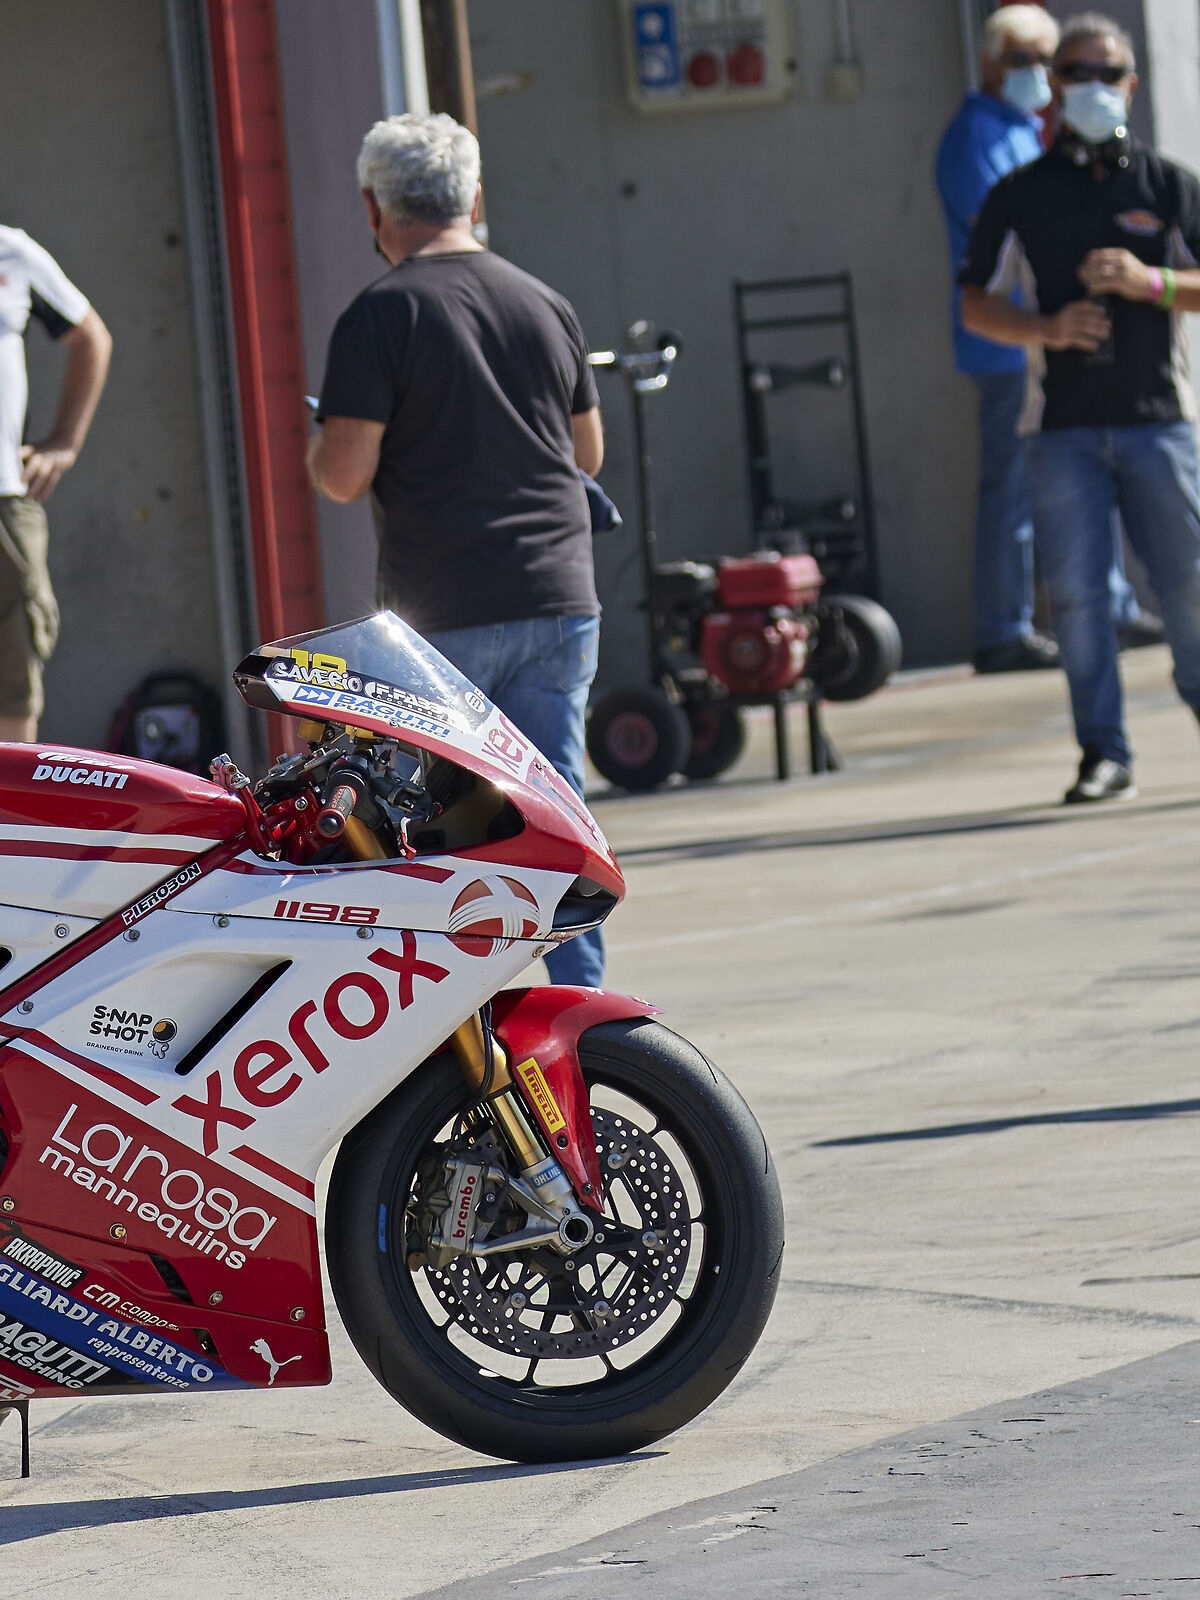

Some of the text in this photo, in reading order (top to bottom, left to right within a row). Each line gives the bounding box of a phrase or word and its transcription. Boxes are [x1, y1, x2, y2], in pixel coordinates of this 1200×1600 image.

[337, 693, 450, 736] BAGUTTI
[32, 764, 129, 790] DUCATI
[273, 899, 380, 925] 1198
[86, 1041, 144, 1057] BRAINERGY DRINK
[89, 1020, 149, 1044] SHOT
[171, 930, 451, 1158] xerox
[523, 1065, 560, 1126] PIRELLI
[38, 1146, 247, 1270] mannequins
[452, 1175, 476, 1239] brembo
[86, 1337, 191, 1389] rappresentanze
[97, 1320, 214, 1382] ALBERTO
